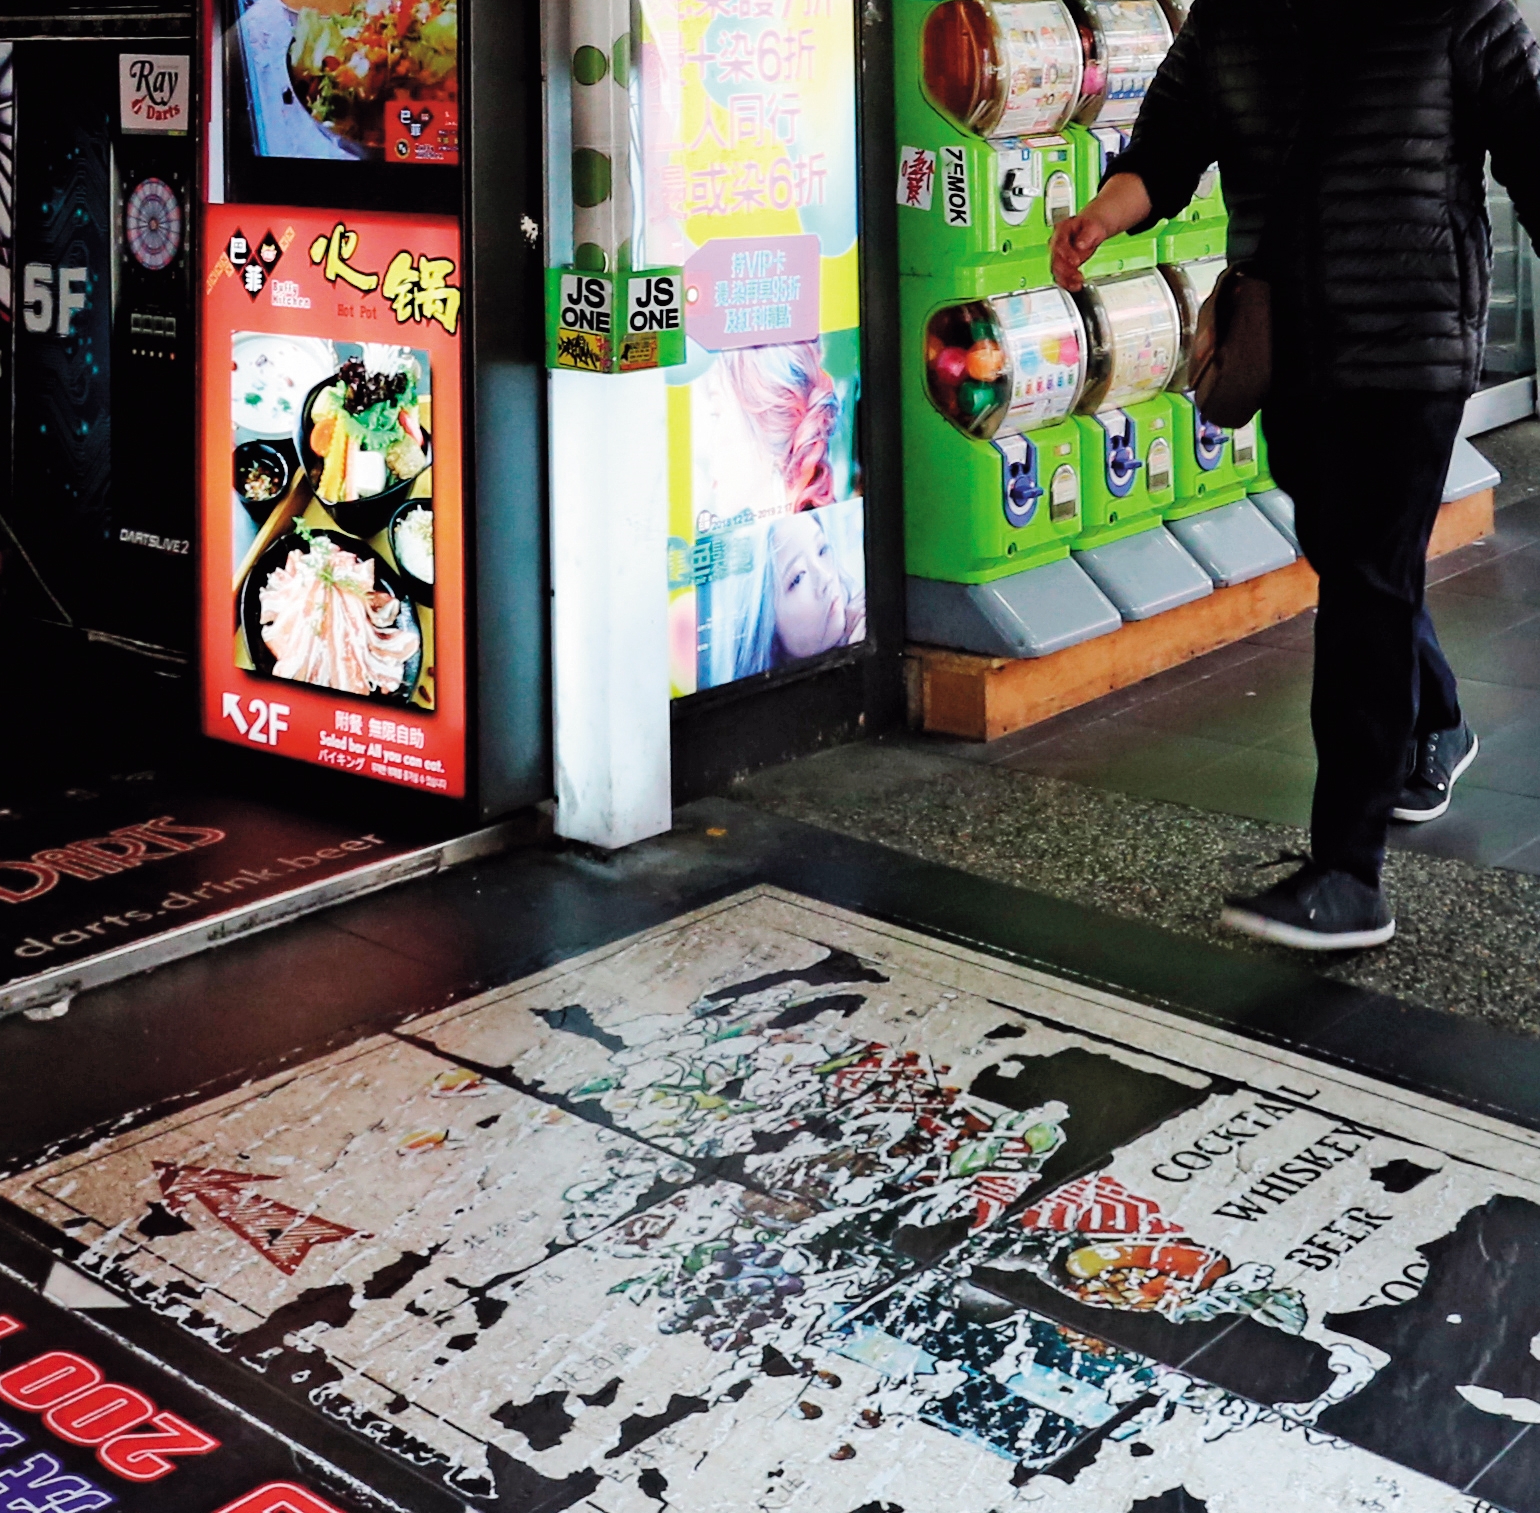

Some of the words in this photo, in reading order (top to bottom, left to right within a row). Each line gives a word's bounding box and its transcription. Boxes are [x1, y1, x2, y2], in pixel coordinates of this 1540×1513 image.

[129, 59, 179, 105] Ray
[144, 97, 181, 122] Darts
[23, 262, 88, 338] 5F
[567, 276, 606, 310] JS
[635, 276, 674, 309] JS
[561, 306, 611, 334] ONE
[629, 307, 680, 332] ONE
[248, 698, 292, 746] 2F
[14, 831, 386, 960] darts.drink.beer
[1285, 1205, 1395, 1273] BEER
